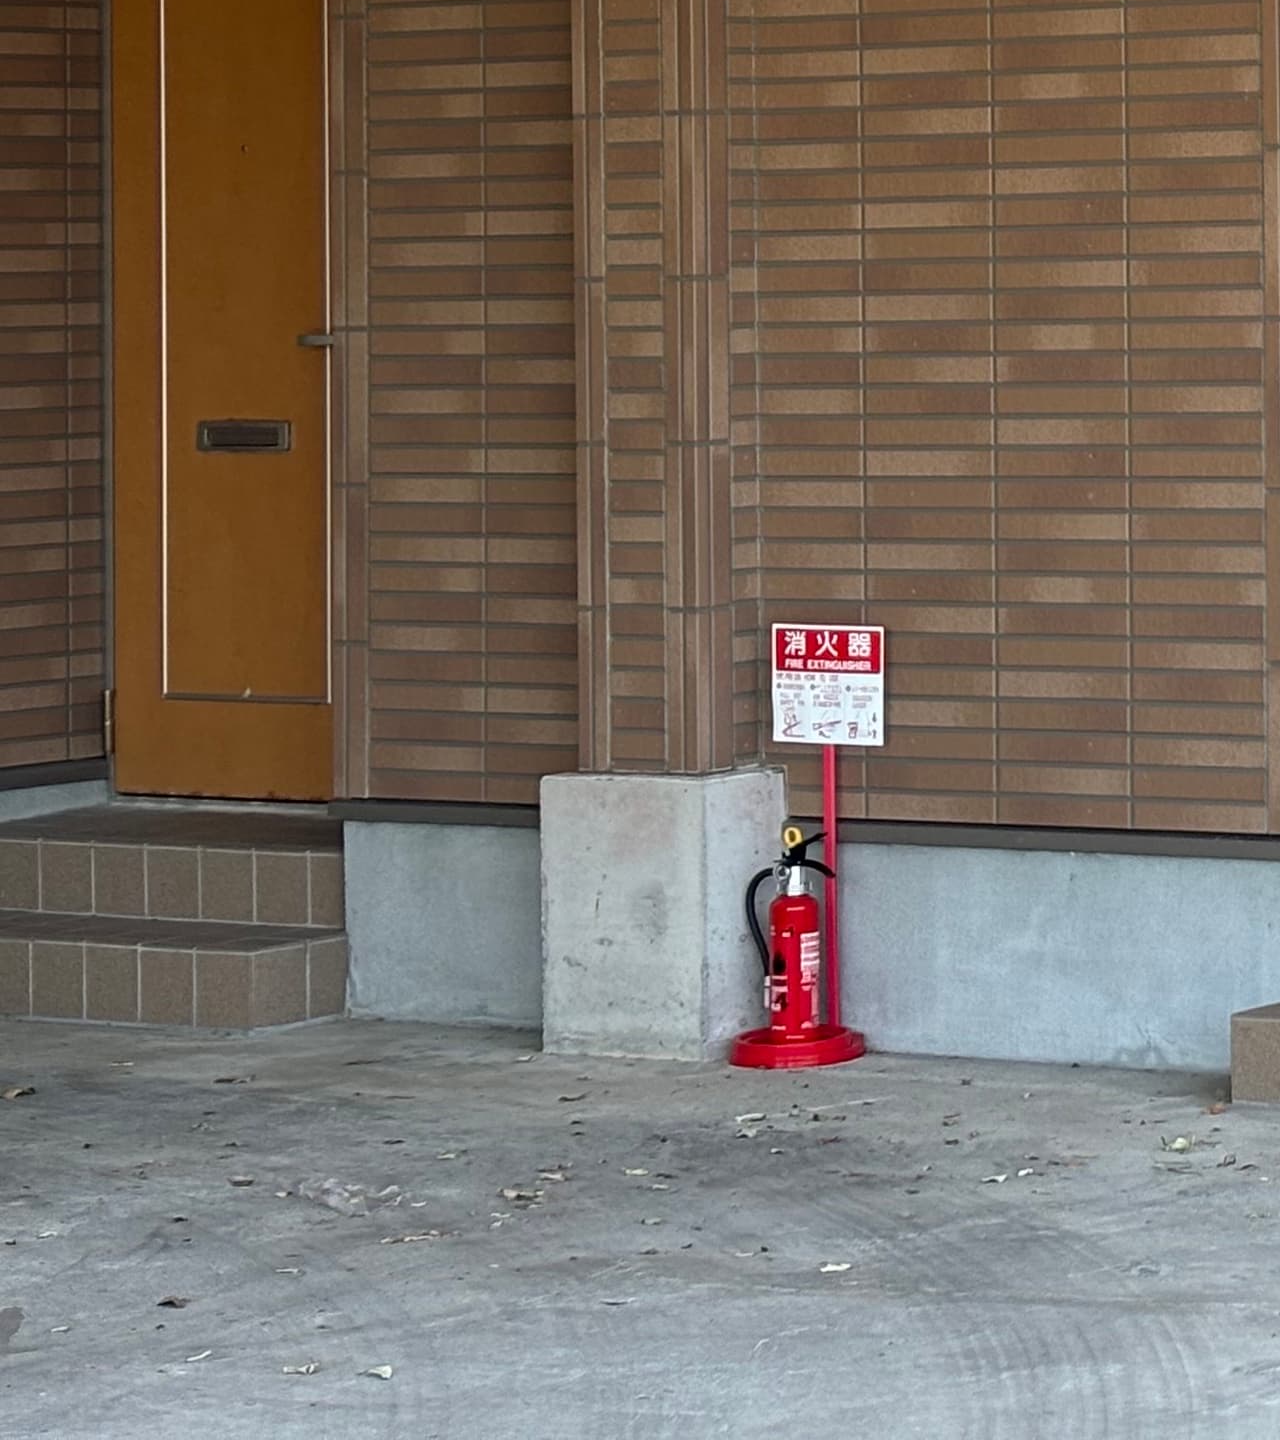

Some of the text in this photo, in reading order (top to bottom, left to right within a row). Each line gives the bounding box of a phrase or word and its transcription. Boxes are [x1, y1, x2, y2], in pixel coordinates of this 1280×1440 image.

[784, 631, 872, 657] 消火器
[785, 659, 872, 671] FIRE EXTINGUISHER
